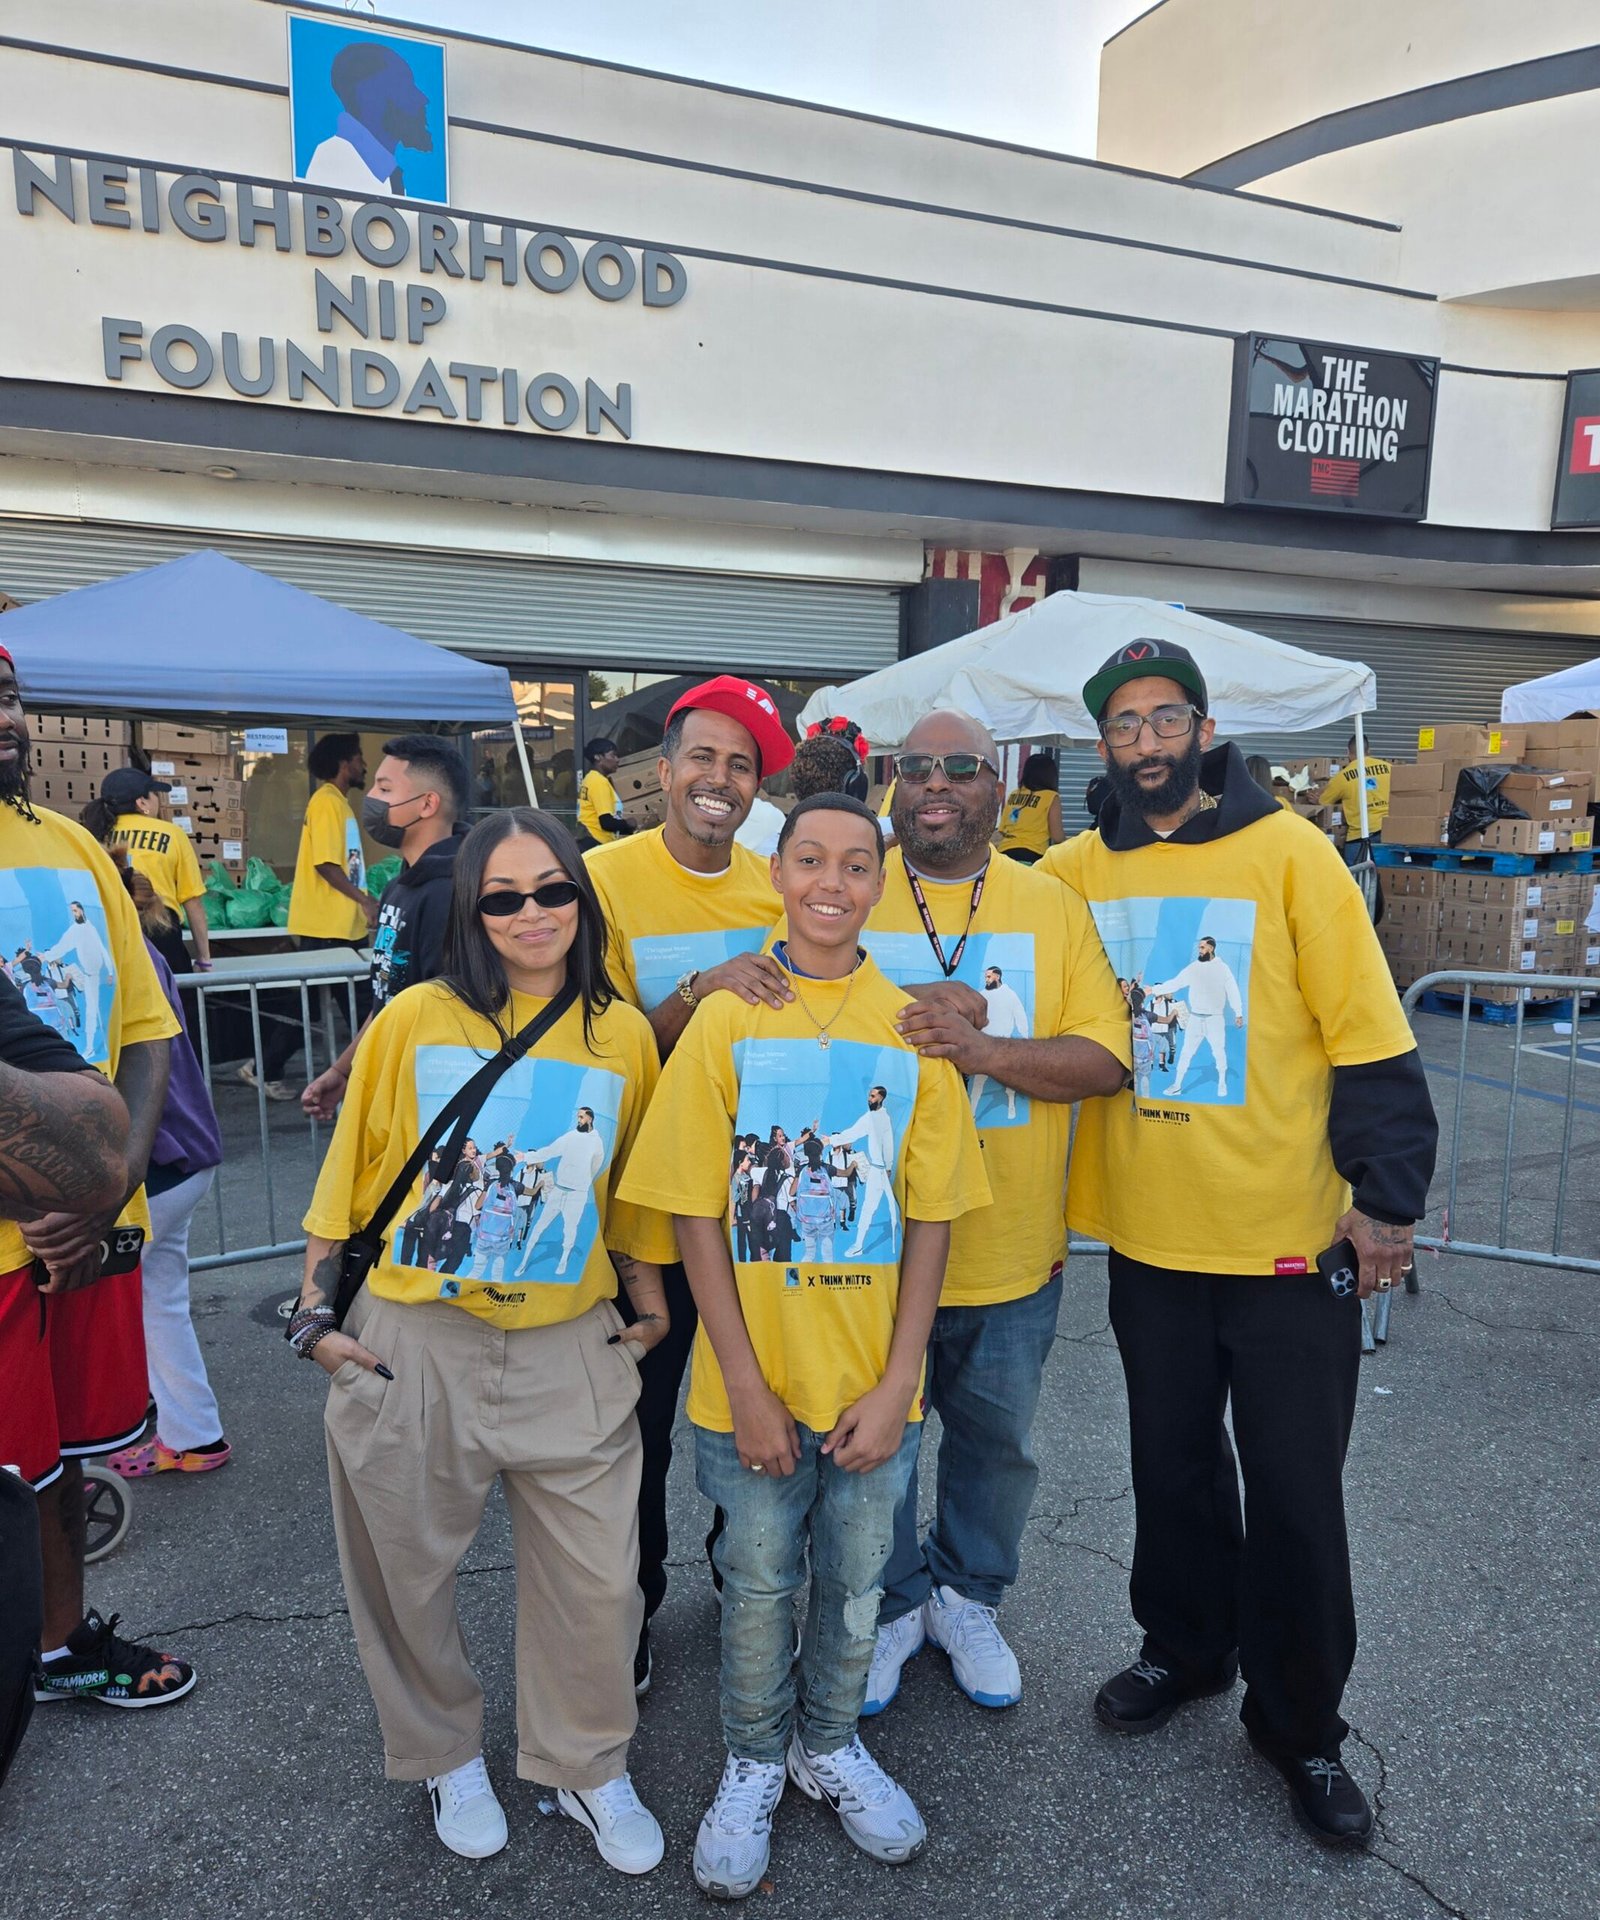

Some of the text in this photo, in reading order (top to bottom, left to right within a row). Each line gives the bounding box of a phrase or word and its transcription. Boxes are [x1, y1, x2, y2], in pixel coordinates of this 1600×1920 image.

[12, 146, 688, 307] NEIGHBORHOOD
[315, 267, 447, 344] NIP
[101, 316, 632, 440] FOUNDATION
[1321, 355, 1369, 393] THE
[1273, 383, 1408, 430] MARATHON
[1277, 419, 1399, 462] CLOTHING
[1313, 462, 1330, 474] TMC
[1139, 1107, 1190, 1122] THINK WATTS
[808, 1274, 872, 1287] X THINK WATTS
[52, 1672, 106, 1687] TEAMWORK
